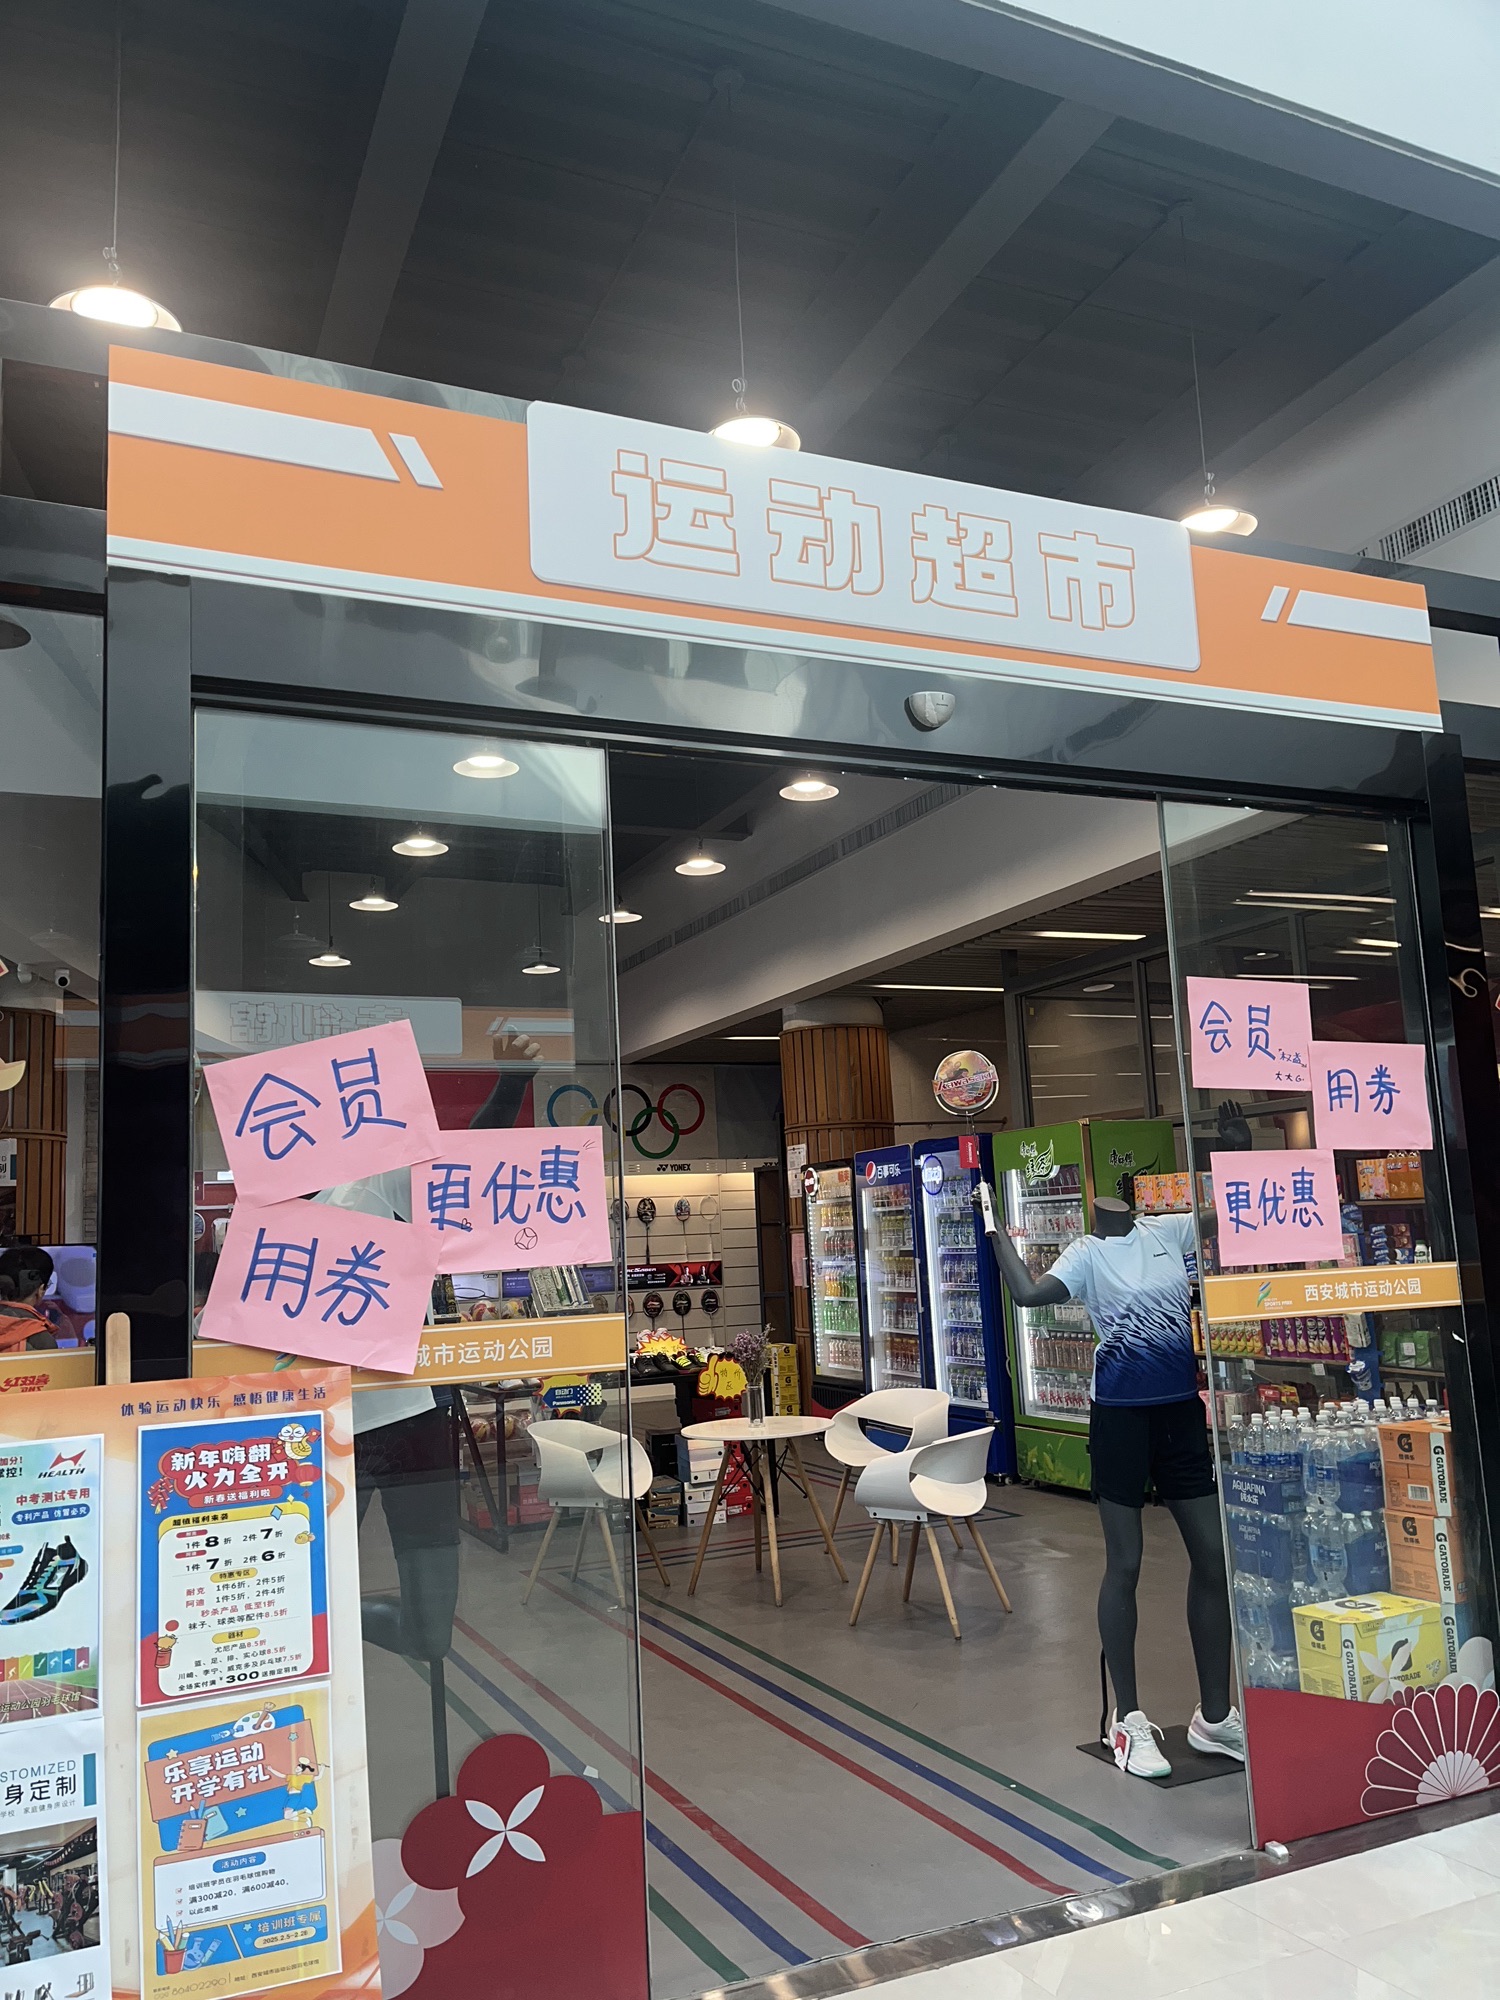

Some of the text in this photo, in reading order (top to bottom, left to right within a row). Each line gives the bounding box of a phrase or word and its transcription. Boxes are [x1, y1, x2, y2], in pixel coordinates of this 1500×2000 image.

[612, 450, 1136, 631] 运动超市
[1200, 1000, 1276, 1061] 会员
[1327, 1064, 1400, 1115] 用券
[236, 1047, 407, 1161] 会员
[670, 1163, 691, 1172] YONEX
[877, 1163, 901, 1178] 百事可乐
[428, 1145, 586, 1232] 更优惠
[1225, 1166, 1324, 1234] 更优惠
[240, 1228, 390, 1326] 用券
[1304, 1278, 1421, 1302] 西安城市运动公园
[0, 1374, 50, 1391] 红双喜
[121, 1386, 326, 1416] 体验运动快乐 感悟健康生活
[171, 1443, 272, 1472] 新年嗨翻
[38, 1467, 86, 1479] HEALTH
[184, 1462, 289, 1491] 火力全开
[1435, 1456, 1448, 1504] GATORADE
[16, 1488, 90, 1506] 中考测试专用
[204, 1488, 271, 1504] 新春送福利啦
[1232, 1479, 1266, 1497] AQUAFINA
[15, 1506, 87, 1523] 专利产品 仿冒必究
[172, 1513, 229, 1527] 超值福利来袭
[219, 1569, 250, 1580] 特惠专区
[1438, 1543, 1451, 1592] GATORADE
[185, 1587, 206, 1597] 耐克
[200, 1599, 276, 1618] 秒杀产品 低至1折
[0, 1691, 81, 1713] 运动公园羽毛球馆
[0, 1759, 76, 1783] STOMIZED
[164, 1742, 265, 1784] 乐享运动
[5, 1773, 77, 1806] 身定制
[171, 1764, 270, 1804] 开学有礼
[23, 1799, 76, 1815] 家庭健身房设计
[221, 1855, 257, 1869] 活动内容
[188, 1904, 219, 1916] 以此类推
[258, 1910, 322, 1933] 培训班专属
